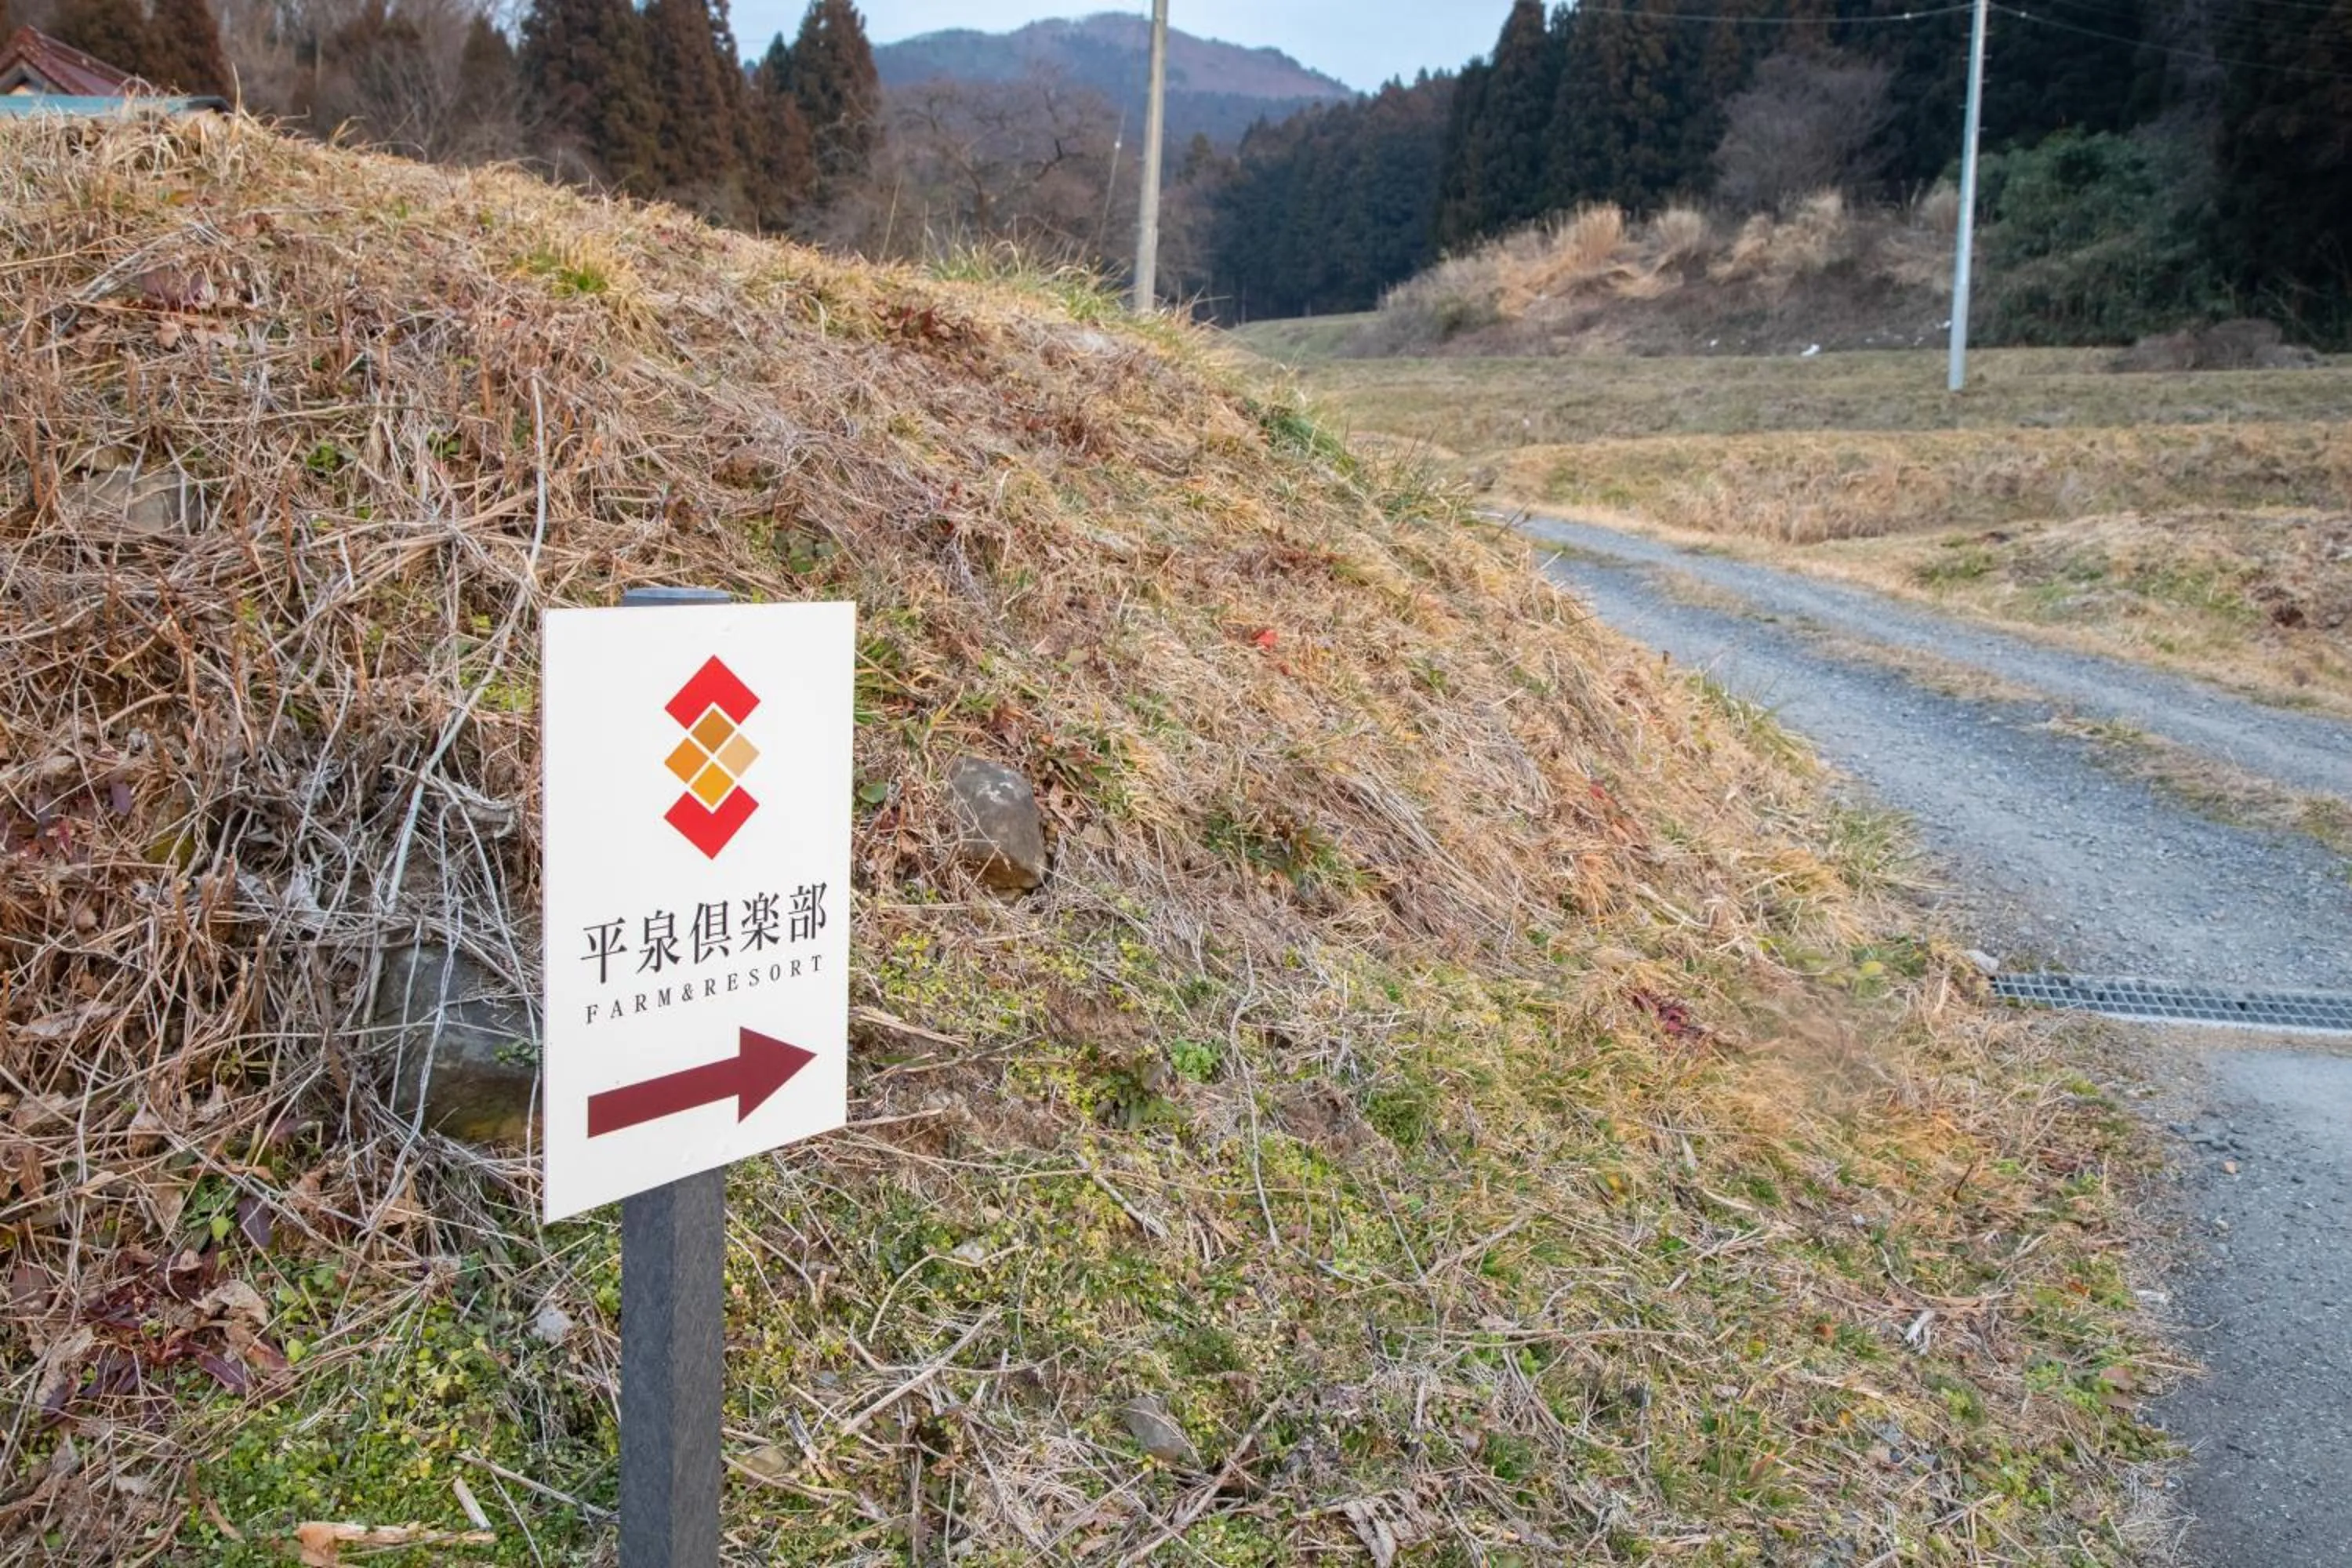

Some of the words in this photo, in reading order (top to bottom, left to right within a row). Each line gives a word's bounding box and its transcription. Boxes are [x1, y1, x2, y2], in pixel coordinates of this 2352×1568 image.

[580, 882, 828, 984] 平泉倶楽部
[586, 955, 823, 1024] FARM&RESORT
